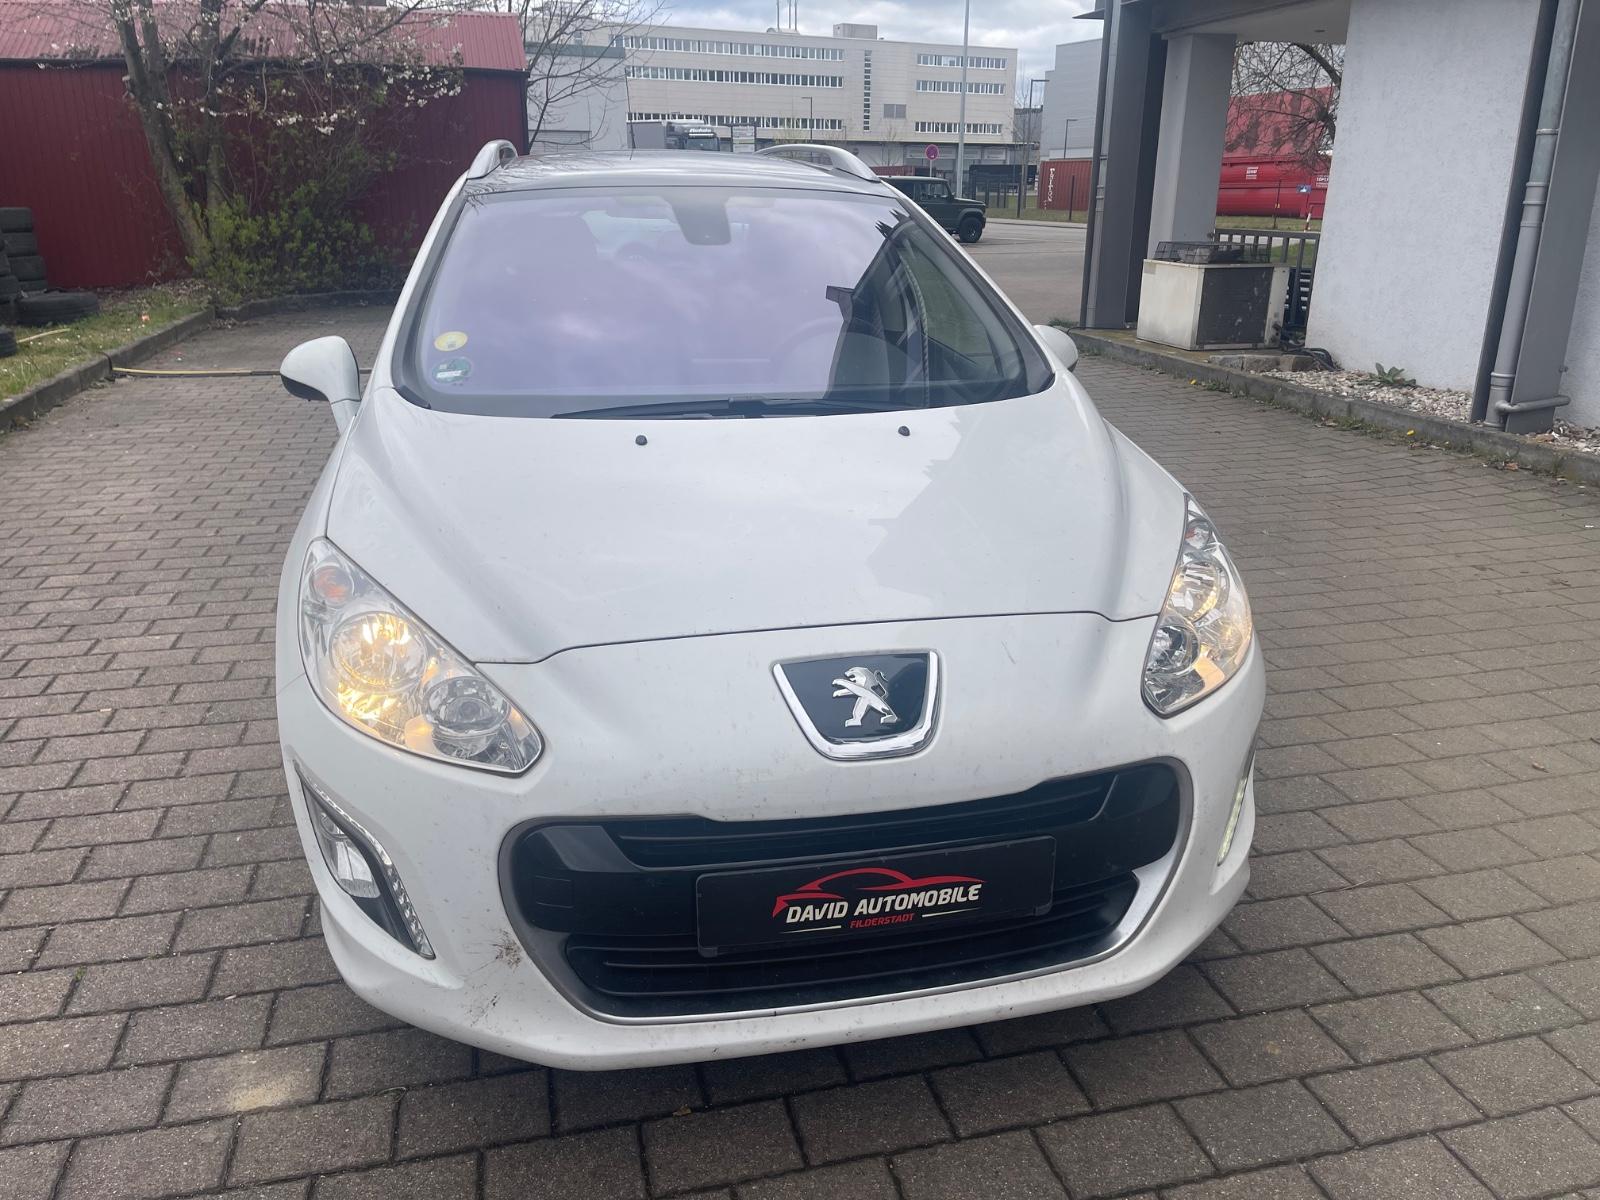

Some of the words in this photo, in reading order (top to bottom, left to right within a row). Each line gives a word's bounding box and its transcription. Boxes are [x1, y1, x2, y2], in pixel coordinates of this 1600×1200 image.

[786, 901, 848, 923] DAVID
[853, 884, 981, 916] AUTOMOBILE
[850, 913, 915, 929] FILDERSTADT
